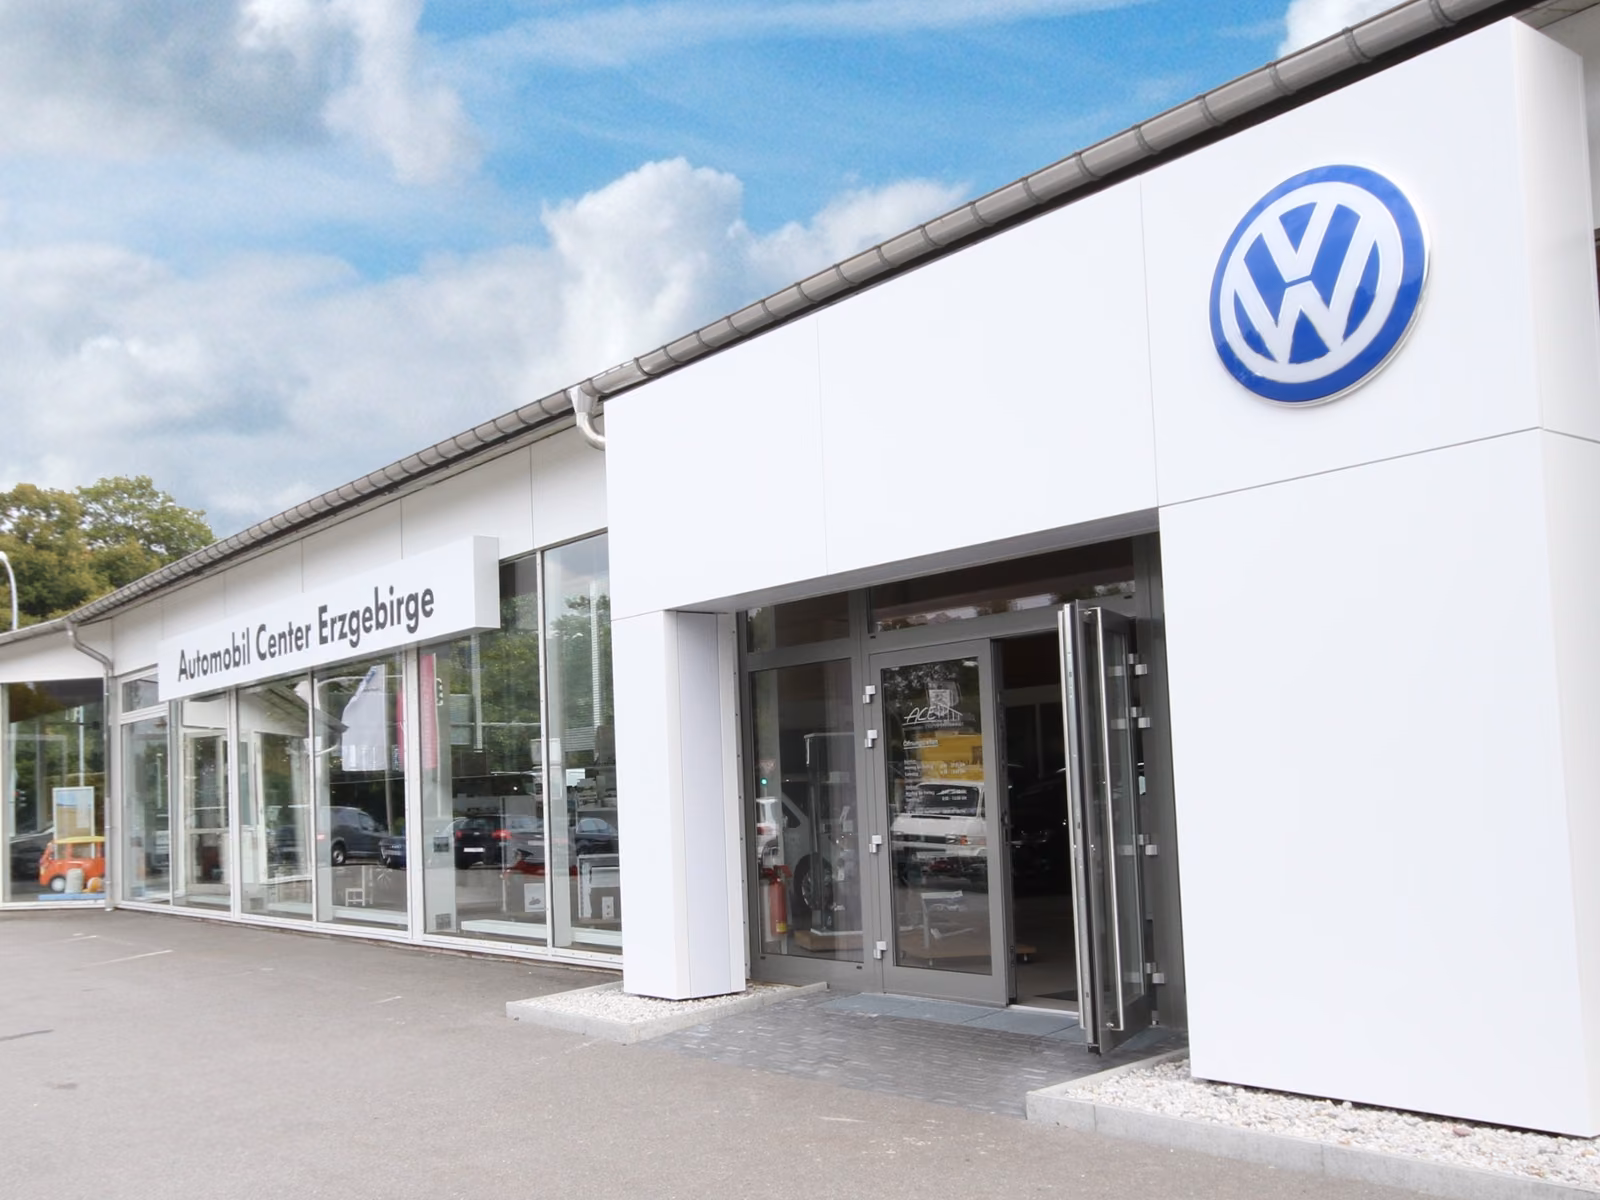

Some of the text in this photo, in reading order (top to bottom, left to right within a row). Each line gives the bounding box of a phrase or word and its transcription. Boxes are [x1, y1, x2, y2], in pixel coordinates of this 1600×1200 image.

[1228, 190, 1388, 373] VW
[178, 585, 435, 682] Automobil Center Erzgebirge
